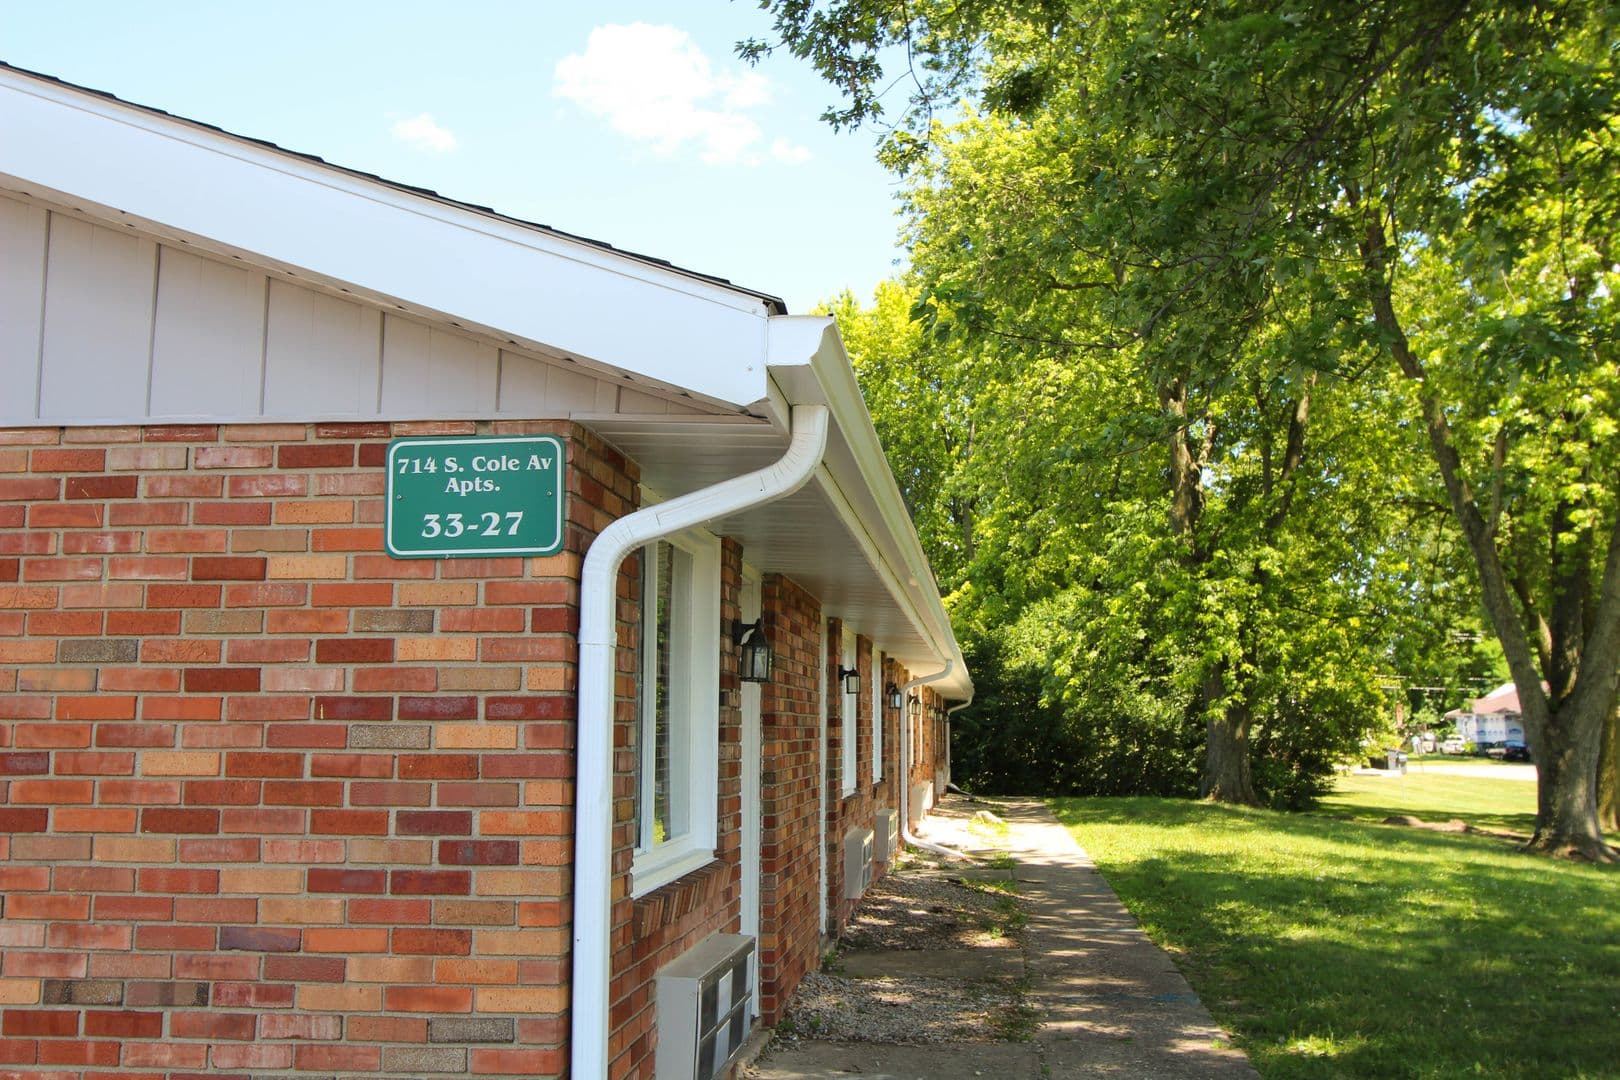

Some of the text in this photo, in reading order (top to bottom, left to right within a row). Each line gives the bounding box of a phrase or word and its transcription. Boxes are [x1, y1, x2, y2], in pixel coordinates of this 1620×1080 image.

[397, 455, 552, 474] 714 S. Cole Av
[444, 477, 501, 496] Apts.
[421, 511, 524, 538] 33-27
